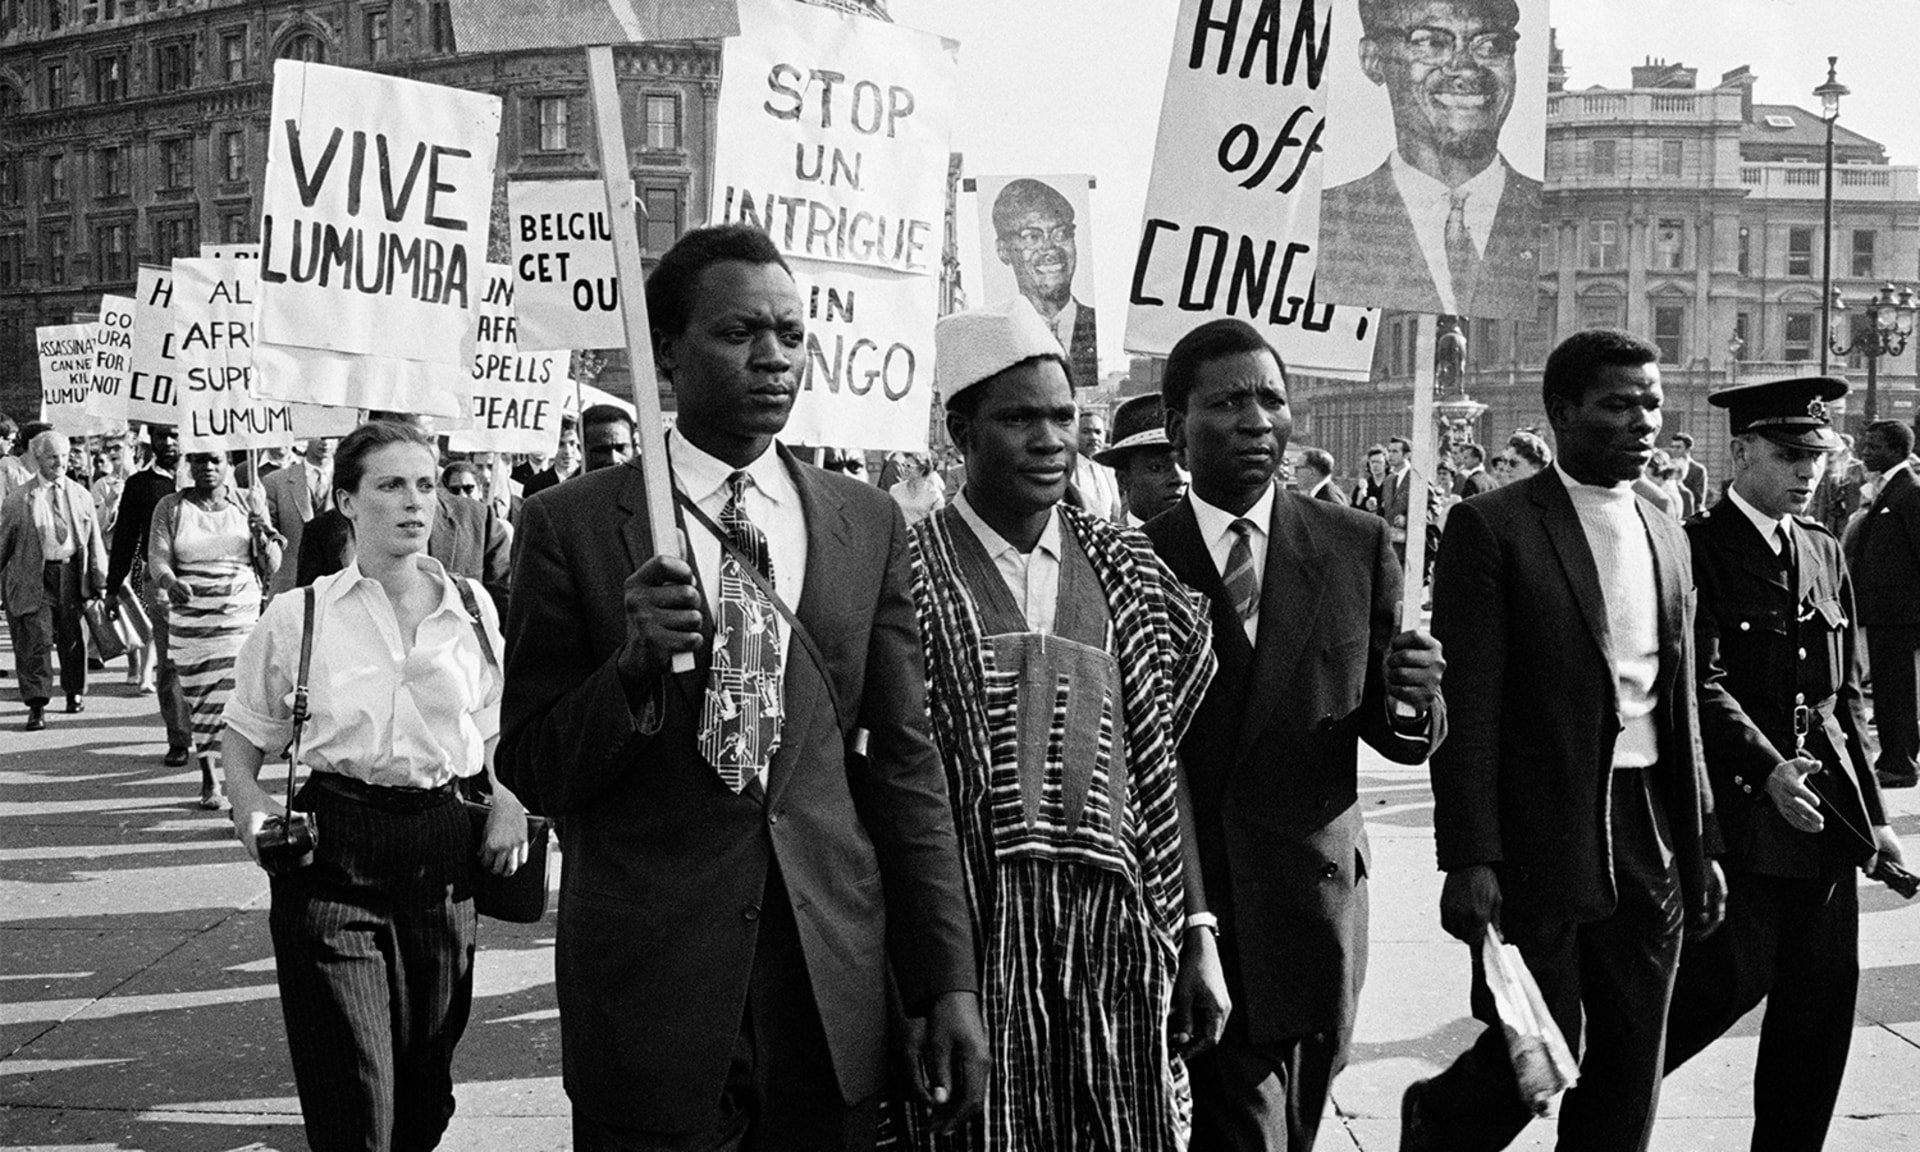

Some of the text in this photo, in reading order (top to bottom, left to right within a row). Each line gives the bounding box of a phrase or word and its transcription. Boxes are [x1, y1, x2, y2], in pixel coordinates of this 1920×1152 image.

[1189, 0, 1332, 90] HAN
[763, 63, 915, 138] STOP
[1218, 105, 1326, 194] off
[285, 119, 472, 231] VIVE
[724, 185, 932, 270] INTRIGUE
[261, 214, 468, 309] LUMUMBA
[519, 252, 570, 283] GET
[208, 280, 253, 305] AL
[573, 277, 618, 312] OU
[1129, 219, 1368, 341] CONG
[104, 311, 132, 329] CO
[809, 285, 855, 324] IN
[97, 330, 132, 349] URA
[51, 360, 73, 372] CAN
[97, 351, 124, 371] FOR
[472, 353, 554, 385] SPELLS
[803, 332, 916, 402] NGO
[44, 387, 89, 406] LUMU
[89, 374, 123, 396] NOT
[130, 371, 178, 407] CO
[192, 407, 292, 438] LUMUM
